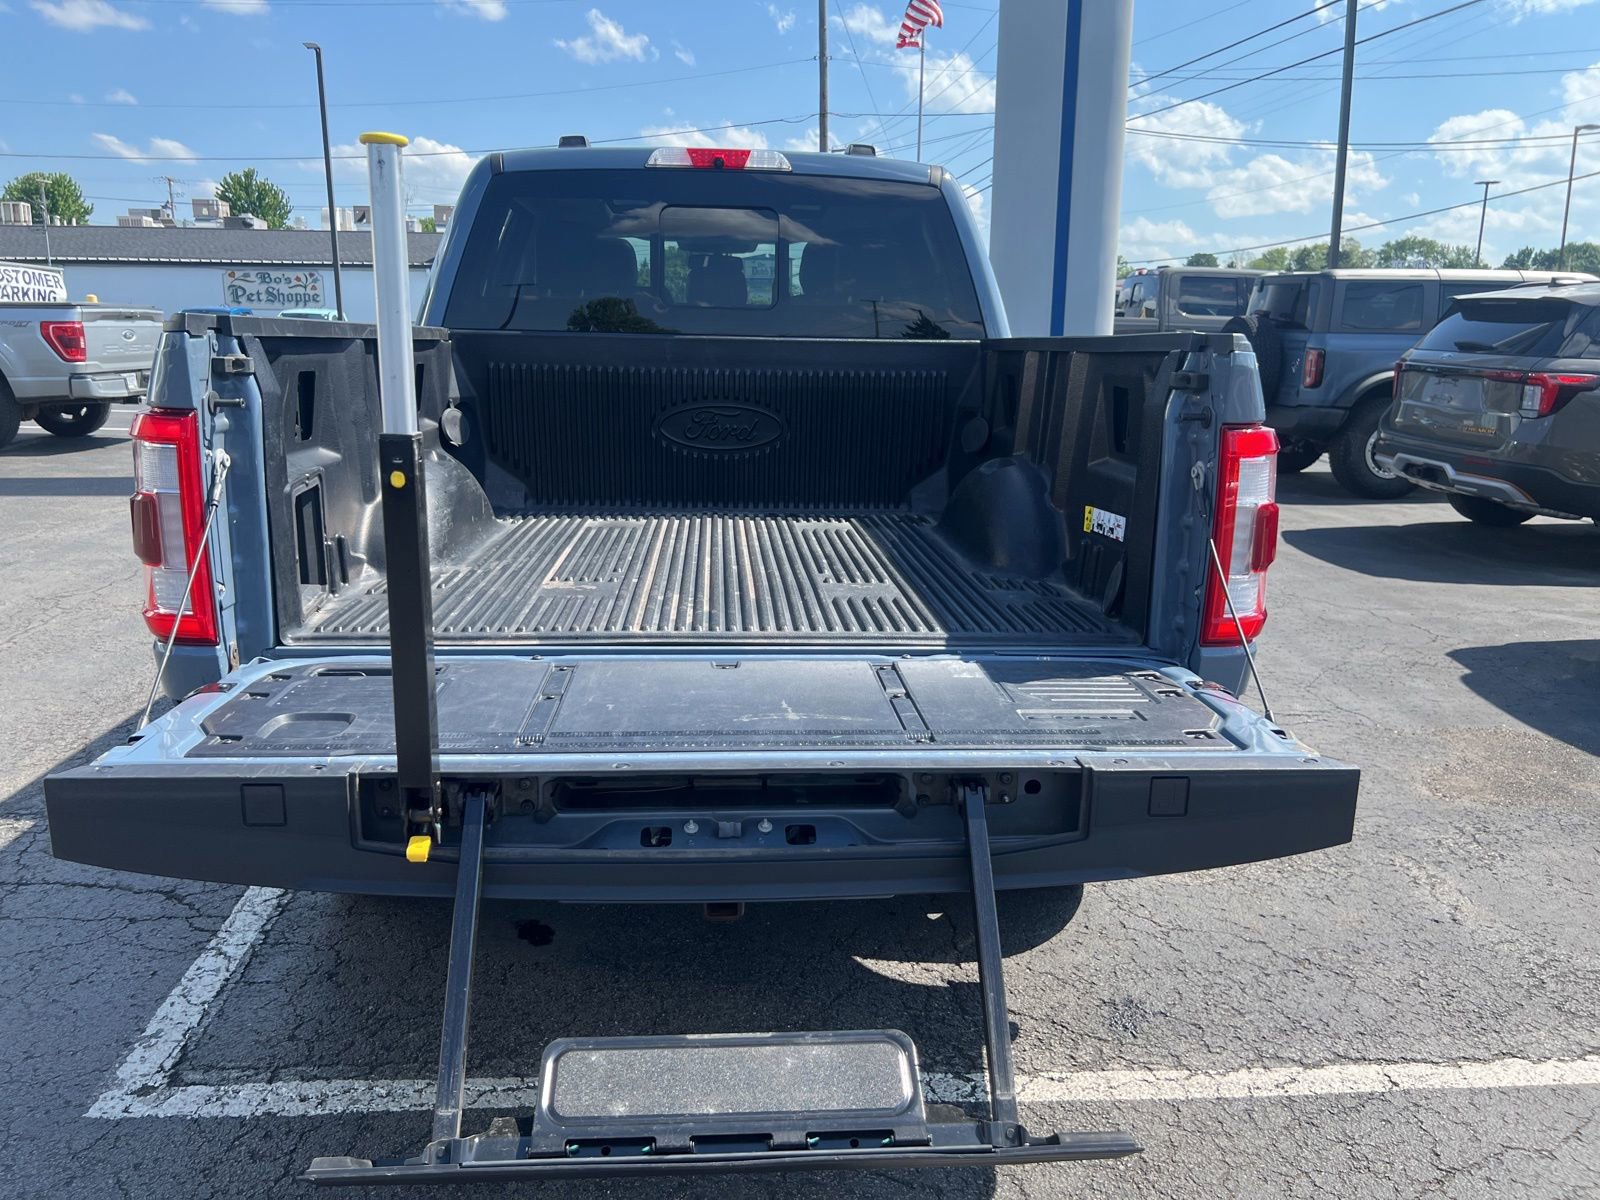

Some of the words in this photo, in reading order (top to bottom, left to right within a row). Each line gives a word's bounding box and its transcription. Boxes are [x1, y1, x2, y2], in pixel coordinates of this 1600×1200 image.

[256, 272, 292, 285] Bo's
[0, 284, 57, 302] ARKING
[228, 284, 264, 305] Pet
[265, 286, 320, 307] Shoppe
[685, 409, 759, 441] Ford
